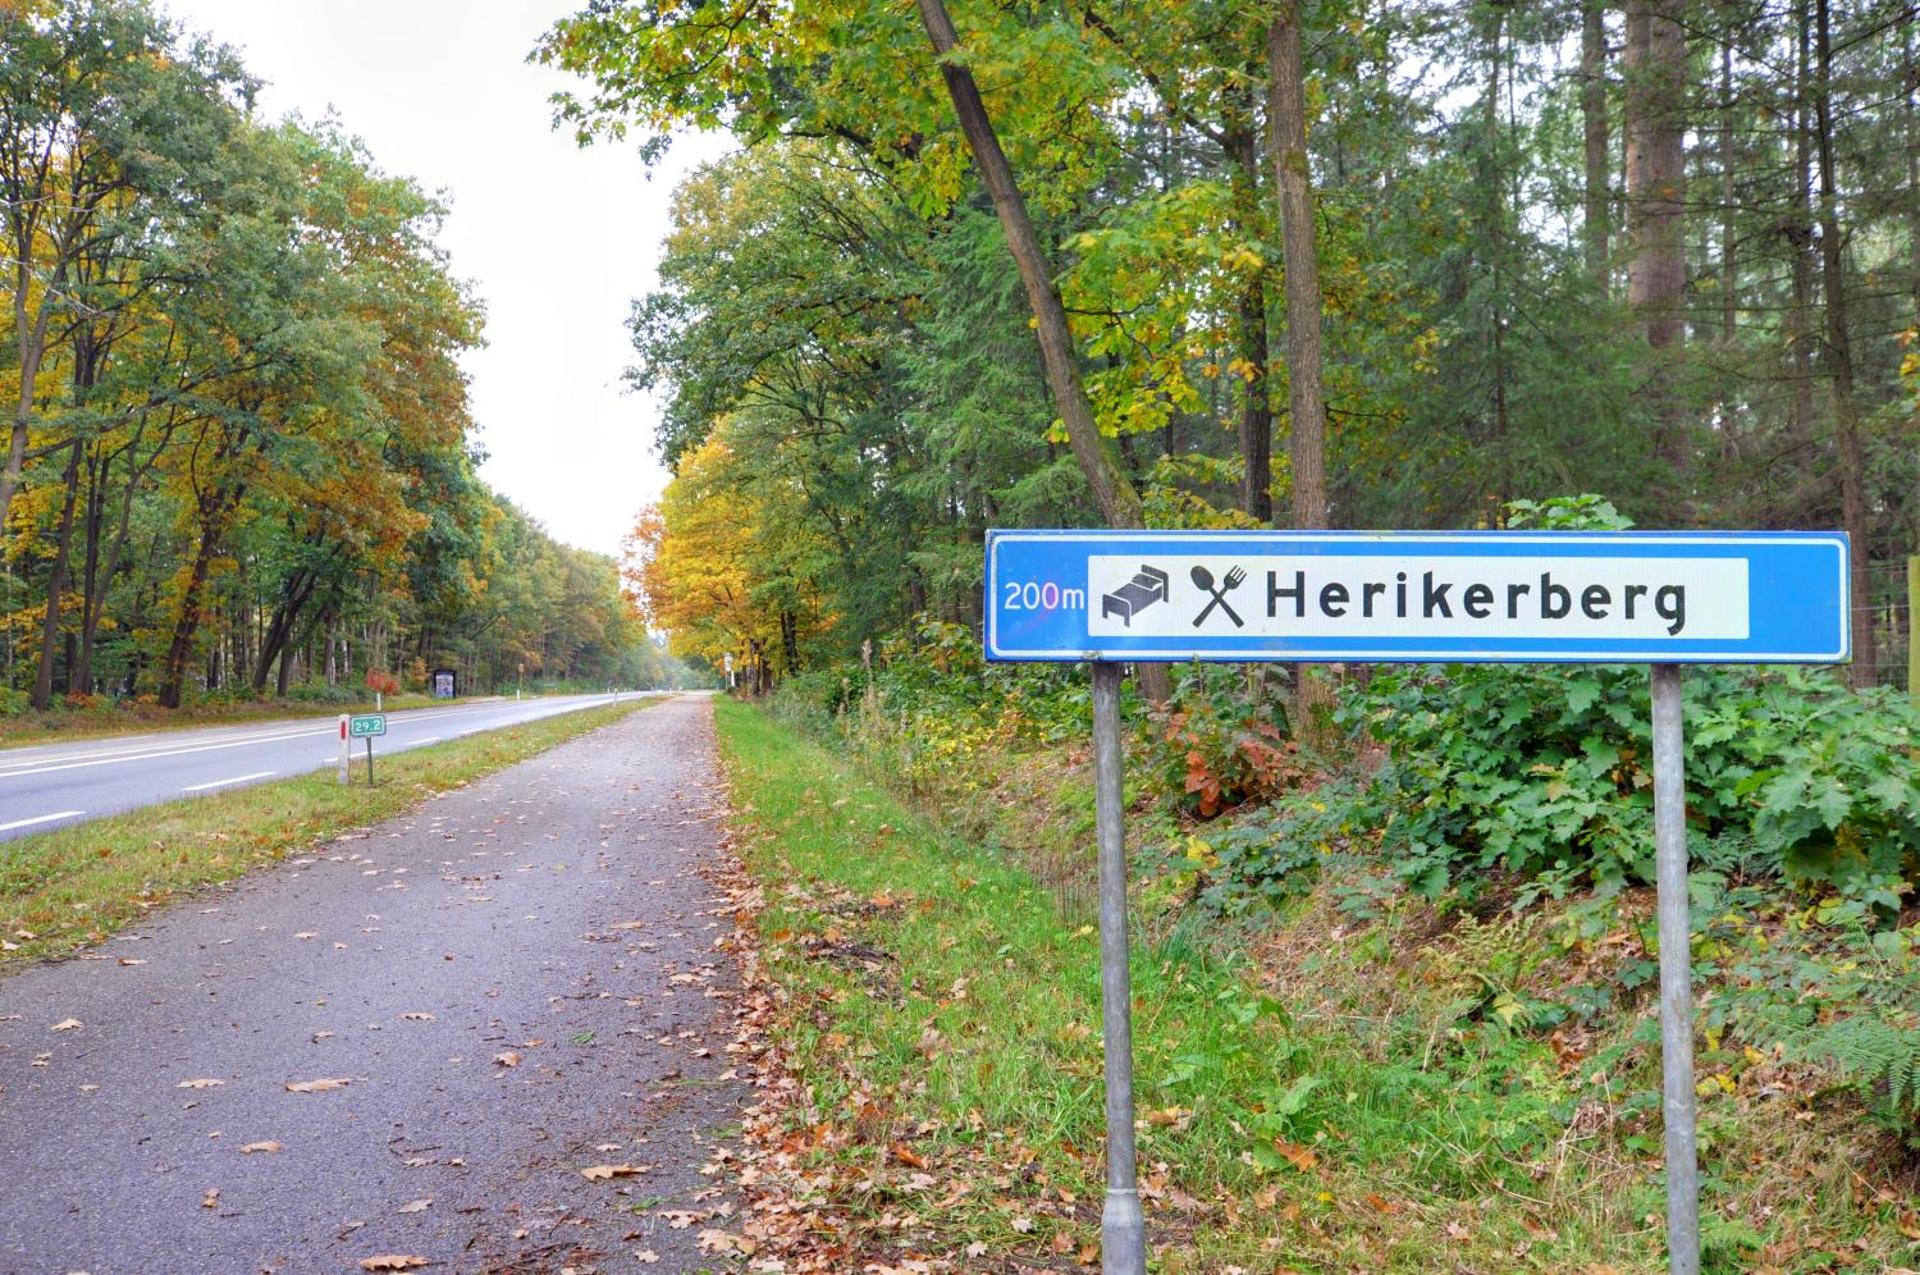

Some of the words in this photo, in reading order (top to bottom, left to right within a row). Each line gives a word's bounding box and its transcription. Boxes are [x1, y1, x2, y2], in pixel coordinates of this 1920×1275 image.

[1004, 581, 1085, 610] 200m
[1267, 570, 1685, 636] Herikerberg
[355, 719, 381, 732] 29.2
